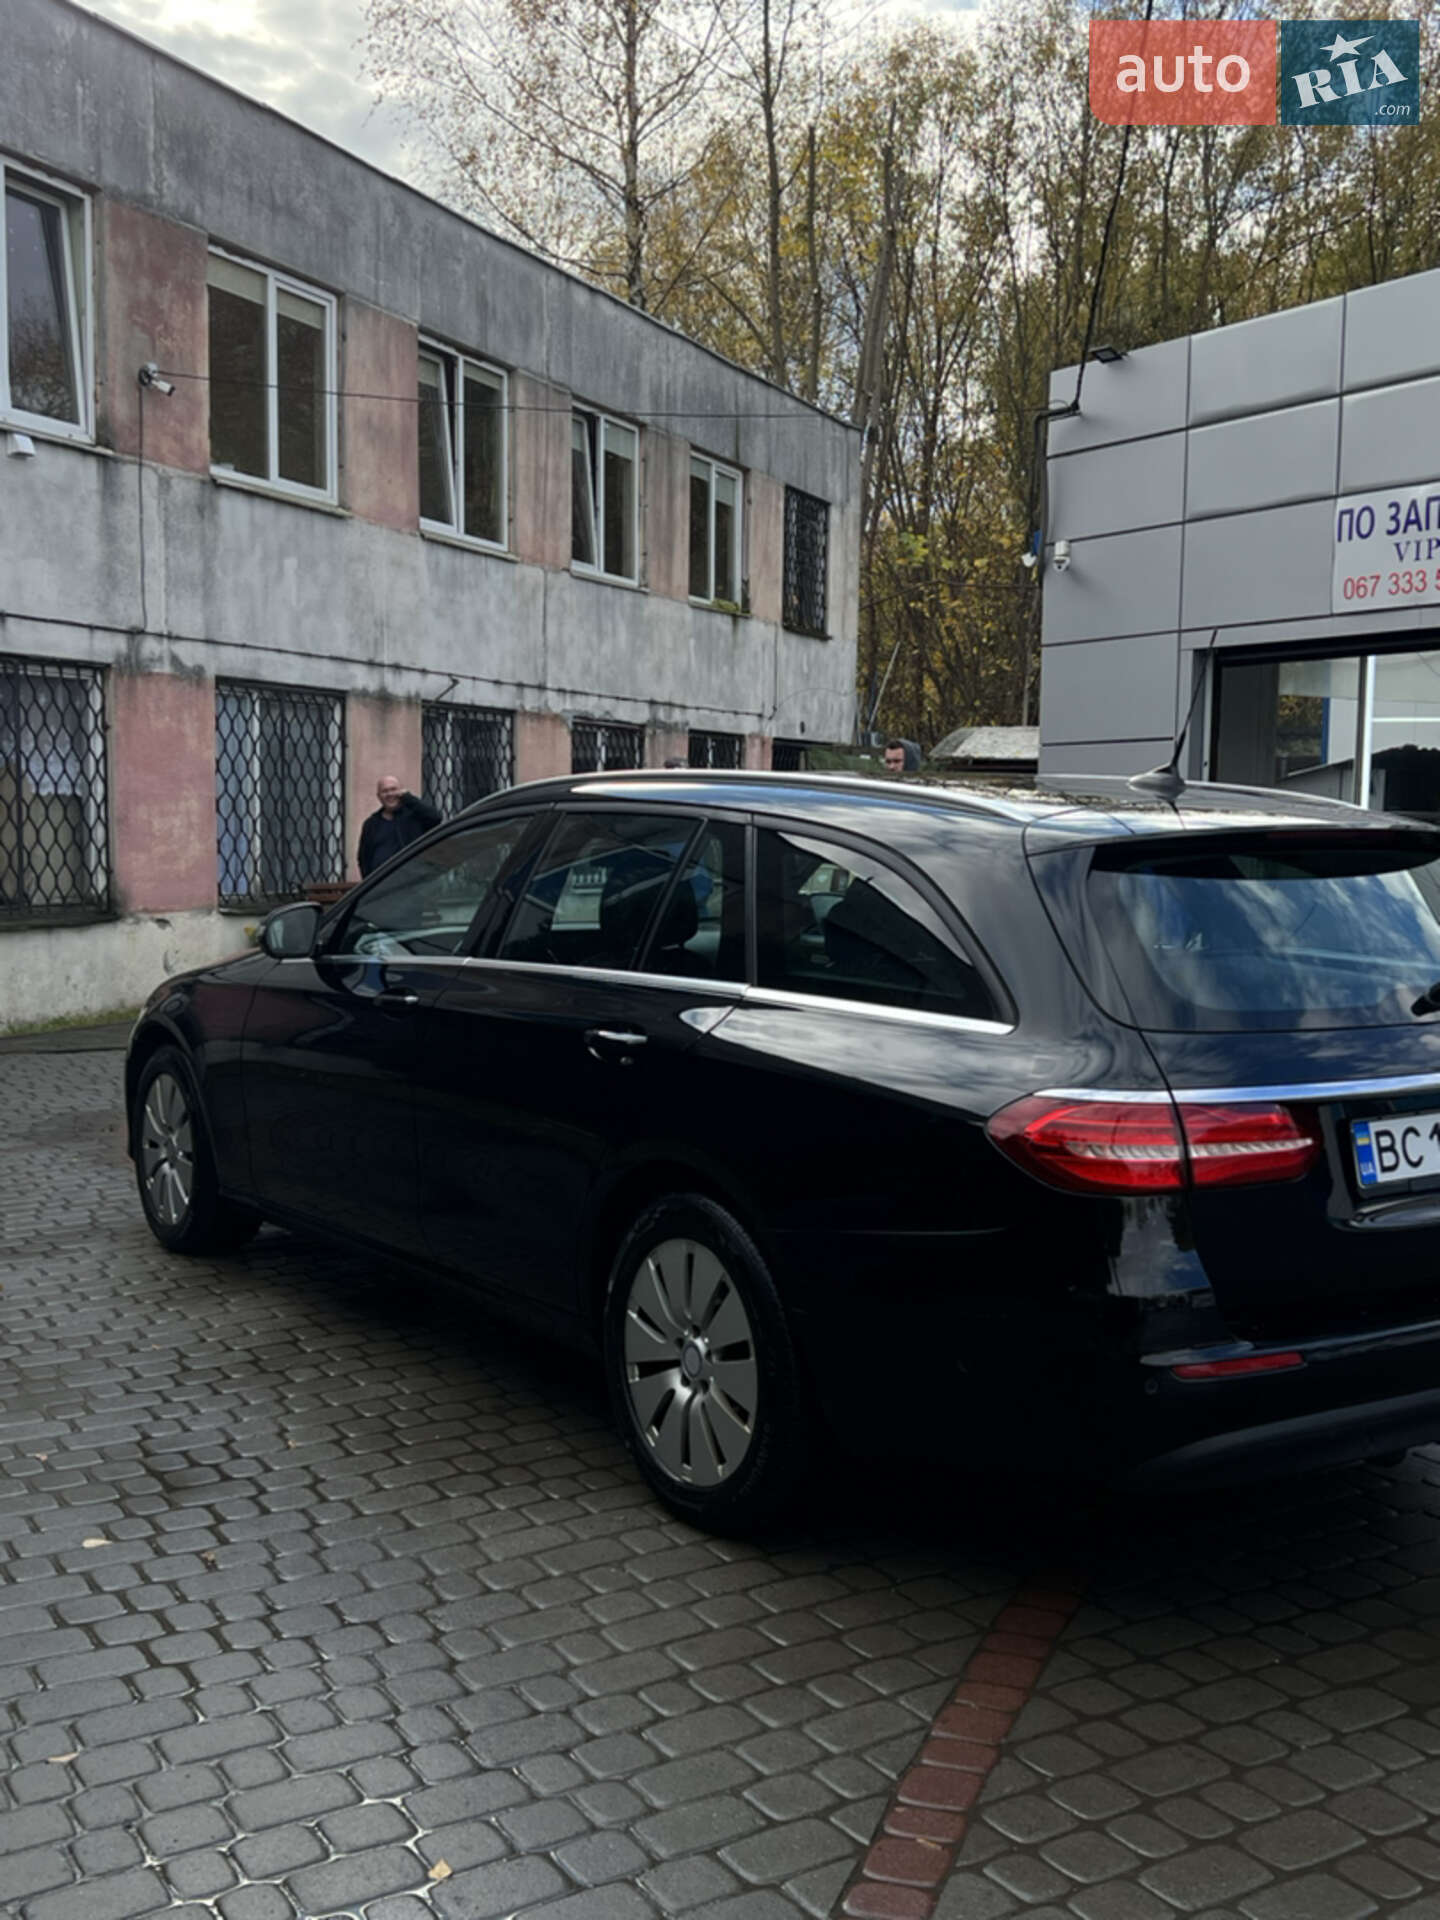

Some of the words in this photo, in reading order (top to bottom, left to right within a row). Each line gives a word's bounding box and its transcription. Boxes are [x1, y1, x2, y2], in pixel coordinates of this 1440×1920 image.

[1337, 505, 1375, 542] ПО
[1393, 537, 1440, 562] VIP
[1343, 574, 1381, 600] 067
[1388, 569, 1427, 595] 333
[1374, 1126, 1424, 1173] BC
